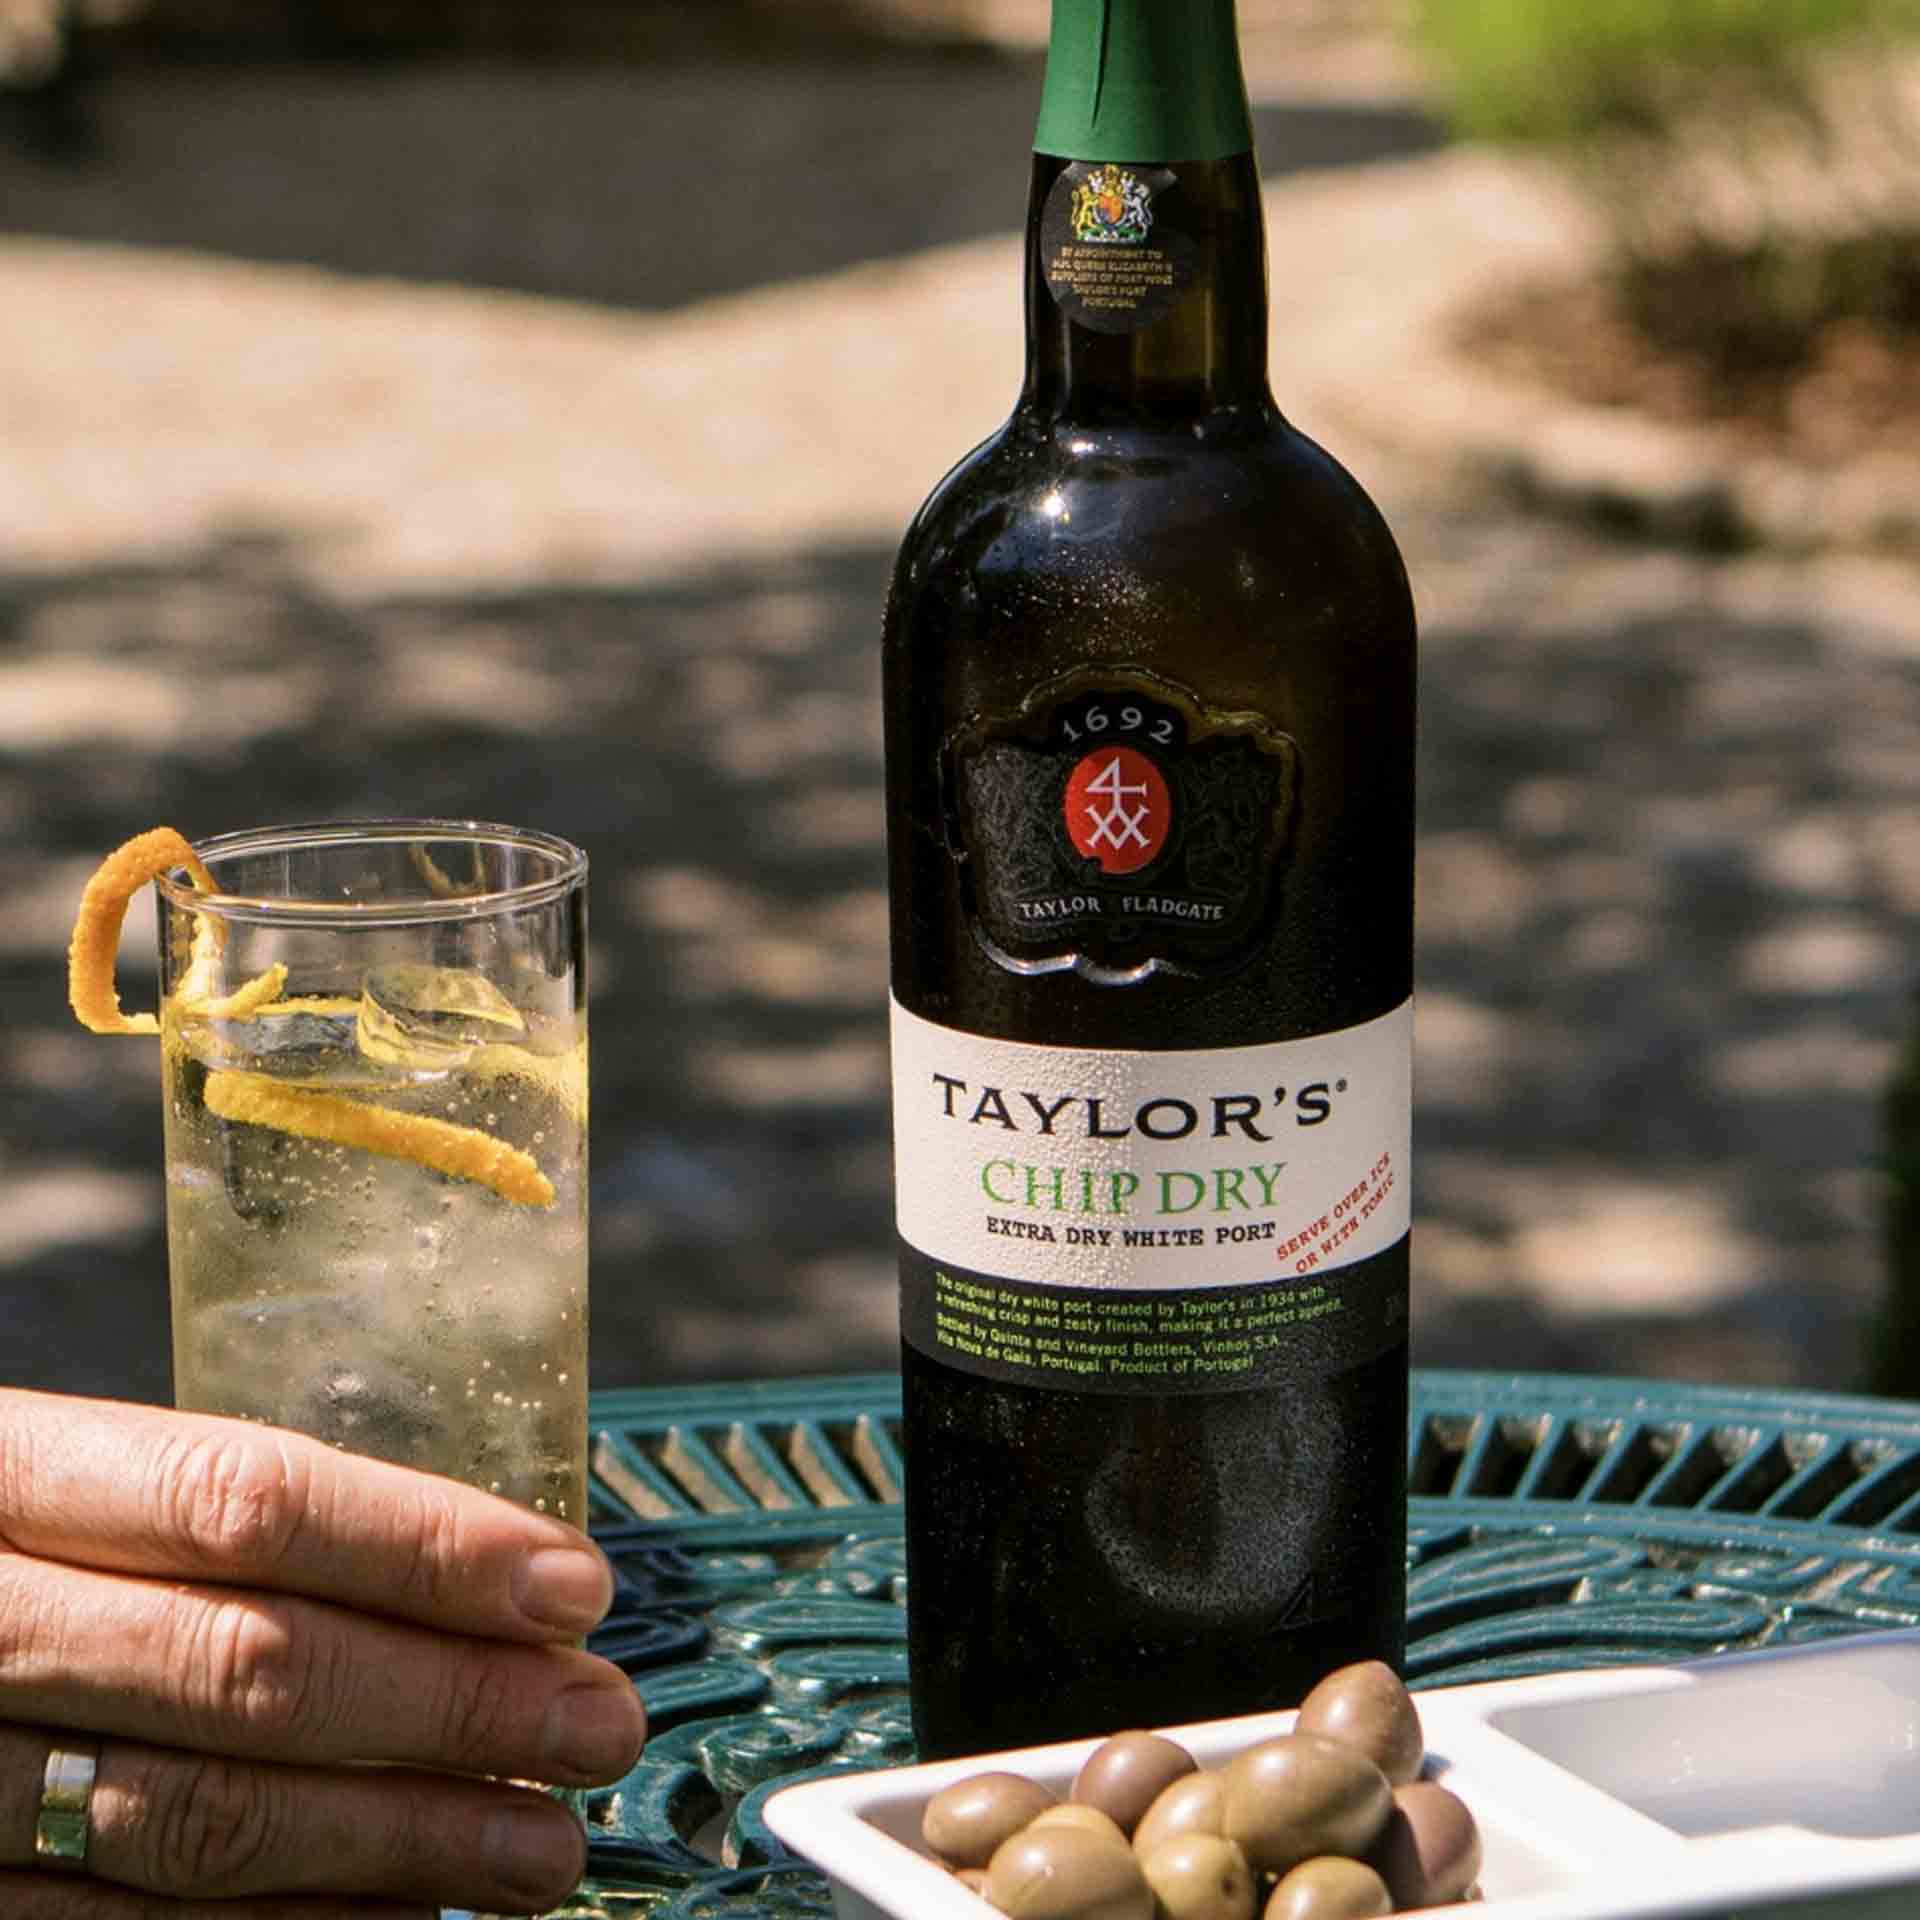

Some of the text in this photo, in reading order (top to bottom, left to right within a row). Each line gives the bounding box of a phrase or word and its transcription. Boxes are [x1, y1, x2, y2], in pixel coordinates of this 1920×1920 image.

[1063, 705, 1174, 744] 1692
[1020, 896, 1224, 920] TAYLOR FLADGATE
[980, 1159, 1287, 1215] CHIP DRY
[1278, 1151, 1390, 1261] SERVE OVER ICE
[986, 1216, 1277, 1248] EXTRA DRY WHITE PORT
[1295, 1171, 1393, 1274] OR WITH TONIC
[935, 1271, 1326, 1317] The original dry white port created by Taylor's in 1934 with
[943, 1293, 997, 1321] refreshing
[998, 1309, 1031, 1326] crisp
[1033, 1313, 1060, 1328] and
[1063, 1317, 1102, 1334] zesty
[1105, 1319, 1153, 1336] finish,
[1159, 1318, 1214, 1335] making
[1218, 1316, 1228, 1330] it
[1247, 1309, 1296, 1330] perfect
[974, 1324, 988, 1342] by
[989, 1327, 1031, 1348] Quinta
[1035, 1337, 1061, 1351] and
[1064, 1338, 1128, 1358] Vineyard
[1201, 1338, 1250, 1354] Vinhos
[984, 1344, 1000, 1360] de
[1110, 1358, 1168, 1374] Product
[1172, 1359, 1187, 1373] of
[1193, 1354, 1254, 1373] Portugal
